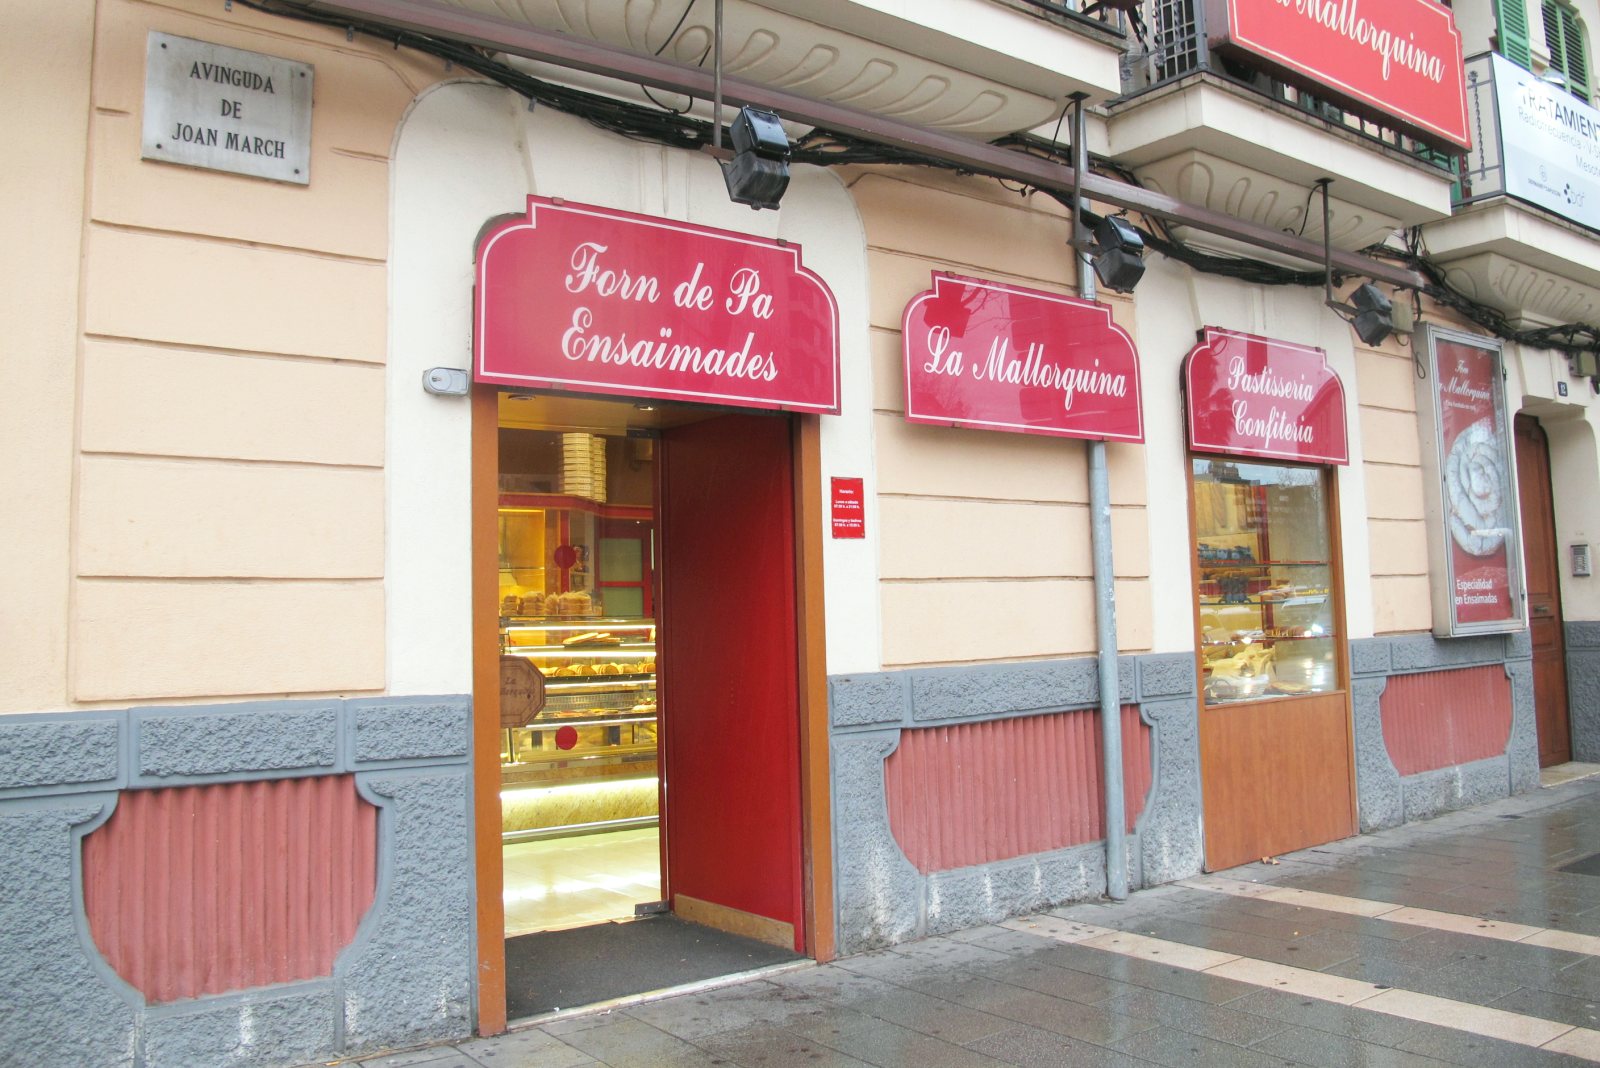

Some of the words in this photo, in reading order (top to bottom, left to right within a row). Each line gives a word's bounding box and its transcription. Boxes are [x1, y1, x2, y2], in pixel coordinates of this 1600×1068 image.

[190, 61, 275, 94] AVINGUDA
[221, 98, 242, 120] DE
[172, 122, 218, 147] JOAN
[225, 132, 285, 159] MARCH
[565, 242, 660, 303] Forn
[673, 262, 714, 311] de
[726, 267, 774, 320] Pa
[561, 307, 778, 381] Ensaïmades
[924, 325, 963, 376] La
[972, 335, 1127, 411] Mallorquina
[1228, 355, 1314, 401] Pastisseria
[1232, 399, 1314, 449] Confiteria
